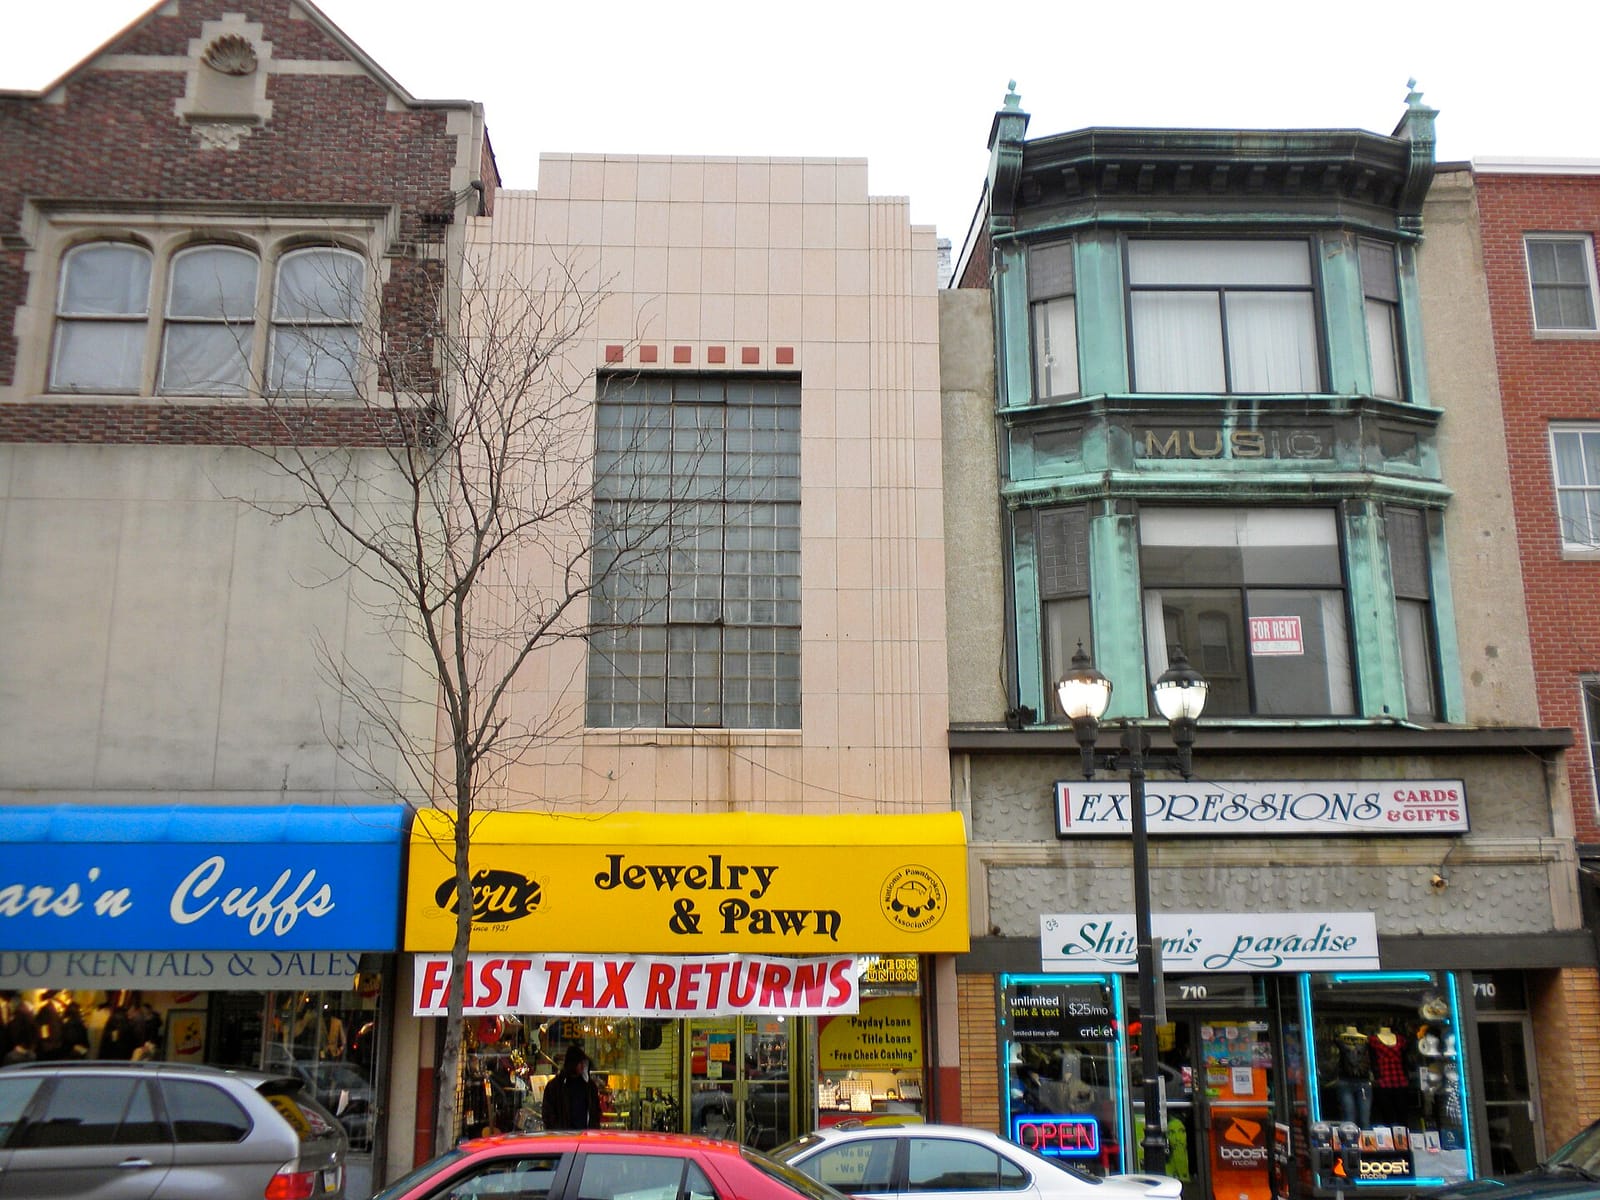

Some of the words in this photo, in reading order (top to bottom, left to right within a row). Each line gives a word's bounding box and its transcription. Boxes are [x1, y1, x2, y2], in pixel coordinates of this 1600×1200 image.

[1145, 430, 1323, 459] MUSIC
[1252, 620, 1271, 639] FOR
[1272, 620, 1297, 639] RENT
[1393, 789, 1458, 802] CARDS
[594, 854, 779, 899] Jewelry
[170, 856, 336, 936] Cuffs
[669, 898, 703, 934] &
[719, 898, 841, 942] Pawn
[1061, 921, 1202, 965] Shim's
[1203, 922, 1357, 969] paradise
[227, 953, 256, 977] &
[867, 970, 918, 982] UNION
[543, 960, 636, 1008] TAX
[644, 959, 853, 1010] RETURNS
[1473, 983, 1496, 997] 710
[1180, 985, 1207, 999] 710
[1010, 996, 1059, 1006] unlimited
[1010, 1008, 1029, 1016] talk
[1031, 1008, 1039, 1016] &
[1041, 1008, 1060, 1016] text
[1069, 1002, 1108, 1016] $25/mo
[851, 1017, 883, 1029] Payday
[885, 1016, 911, 1026] Loans
[1080, 1025, 1114, 1037] cricket
[862, 1034, 883, 1044] Title
[885, 1034, 911, 1044] Loans
[834, 1049, 852, 1060] Free
[853, 1049, 879, 1060] Check
[1020, 1123, 1095, 1150] OPEN
[1220, 1146, 1268, 1159] boost
[1359, 1159, 1409, 1174] boost
